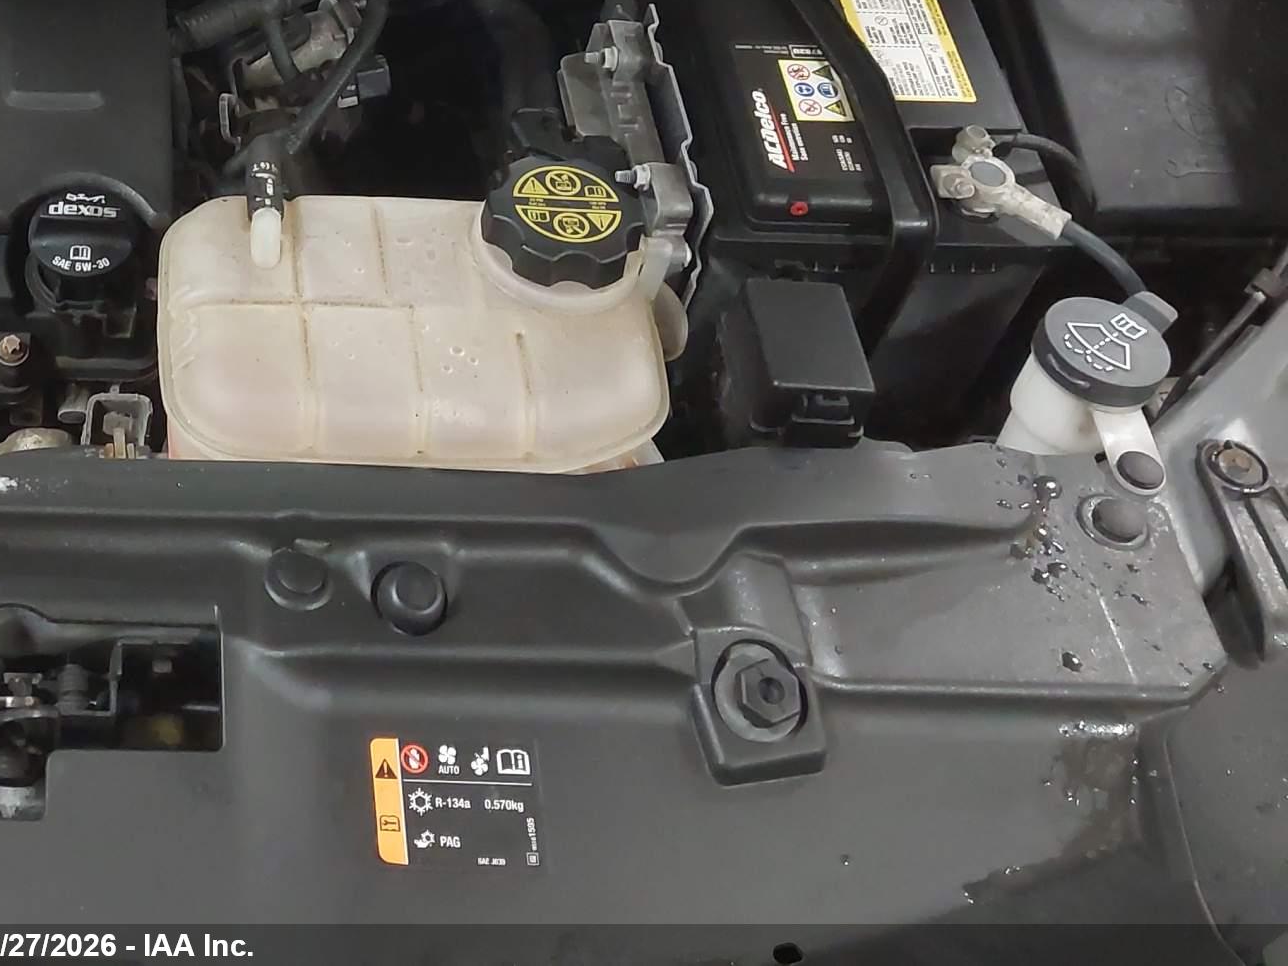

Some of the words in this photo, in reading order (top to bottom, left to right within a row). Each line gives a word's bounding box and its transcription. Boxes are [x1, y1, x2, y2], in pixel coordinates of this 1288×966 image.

[752, 91, 788, 170] ACDelco
[48, 201, 121, 218] dexos
[52, 256, 72, 271] SAE
[75, 257, 111, 272] 5W-30
[438, 764, 460, 775] AUTO
[435, 797, 471, 809] R-134a
[484, 799, 524, 813] 0.570kg
[440, 836, 461, 848] PAG
